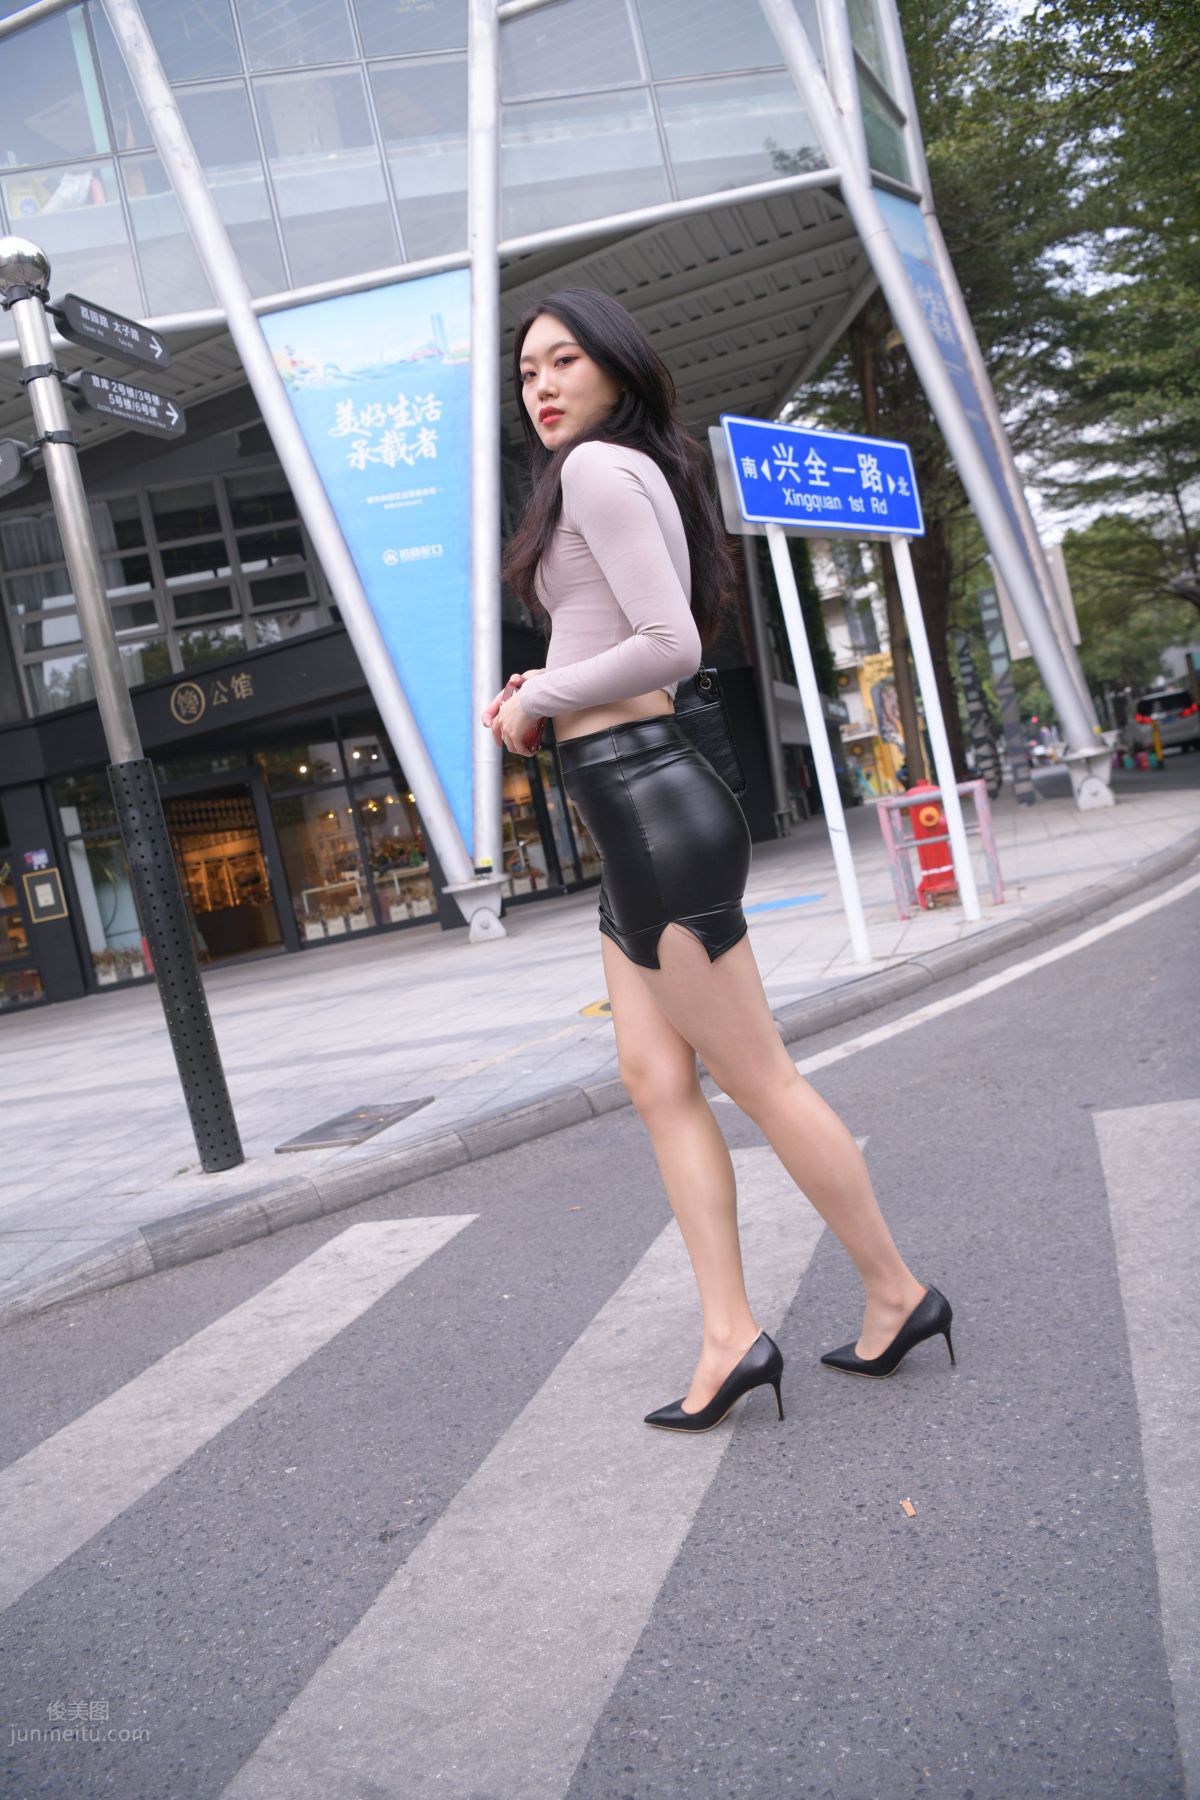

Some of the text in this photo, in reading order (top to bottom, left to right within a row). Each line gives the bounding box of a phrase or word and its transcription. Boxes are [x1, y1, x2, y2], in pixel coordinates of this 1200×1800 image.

[113, 320, 140, 342] 太子路
[328, 392, 443, 437] 美好生活
[346, 427, 439, 471] 承载者
[740, 442, 911, 497] 南 兴全一路 北
[782, 488, 888, 515] Xingquan 1st Rd
